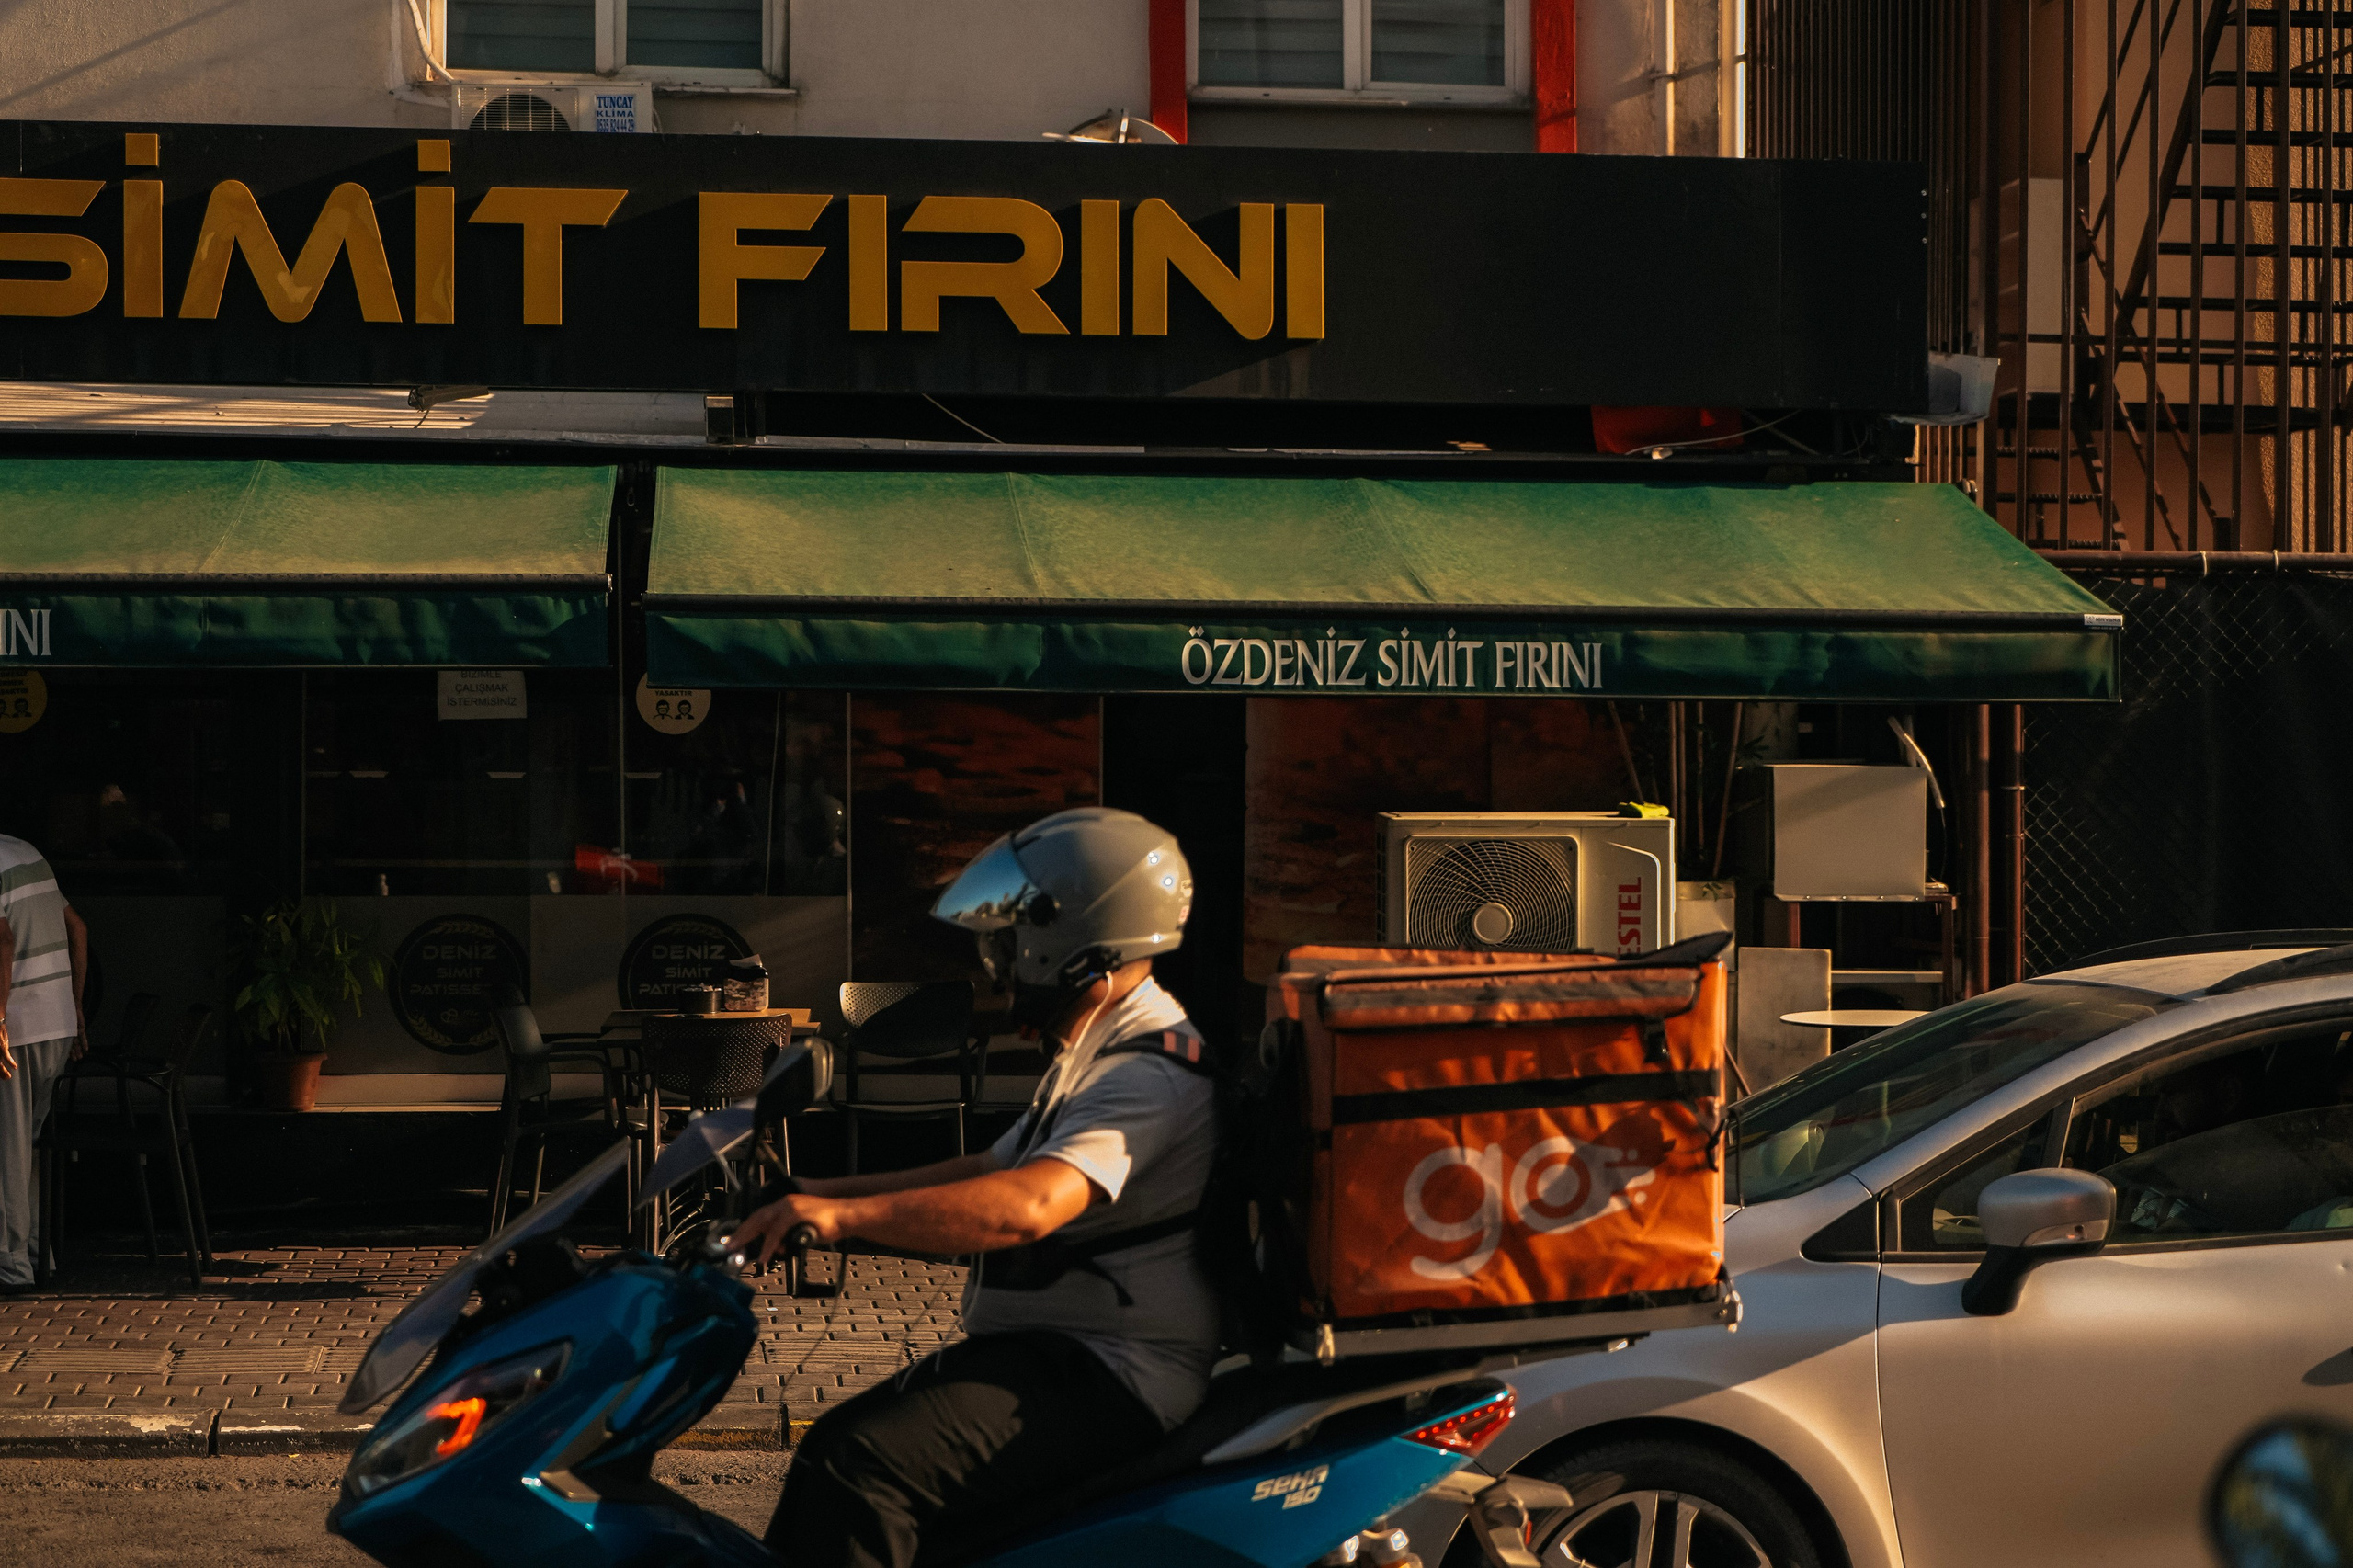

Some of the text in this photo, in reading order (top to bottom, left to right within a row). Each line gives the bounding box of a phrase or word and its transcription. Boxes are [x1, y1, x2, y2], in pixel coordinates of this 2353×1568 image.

[597, 96, 634, 108] TUNCAY
[597, 108, 634, 118] KLİMA
[0, 133, 1324, 341] SİMİT FIRINI
[1181, 626, 1604, 689] ÖZDENİZ SİMİT FIRINI
[455, 683, 509, 694] ÇALIŞMAK
[447, 696, 517, 707] İSTERMİSİNİZ
[422, 940, 497, 960] DENİZ
[651, 941, 726, 960] DENİZ
[665, 963, 713, 979] SİMİT
[409, 983, 494, 995] PATISSE
